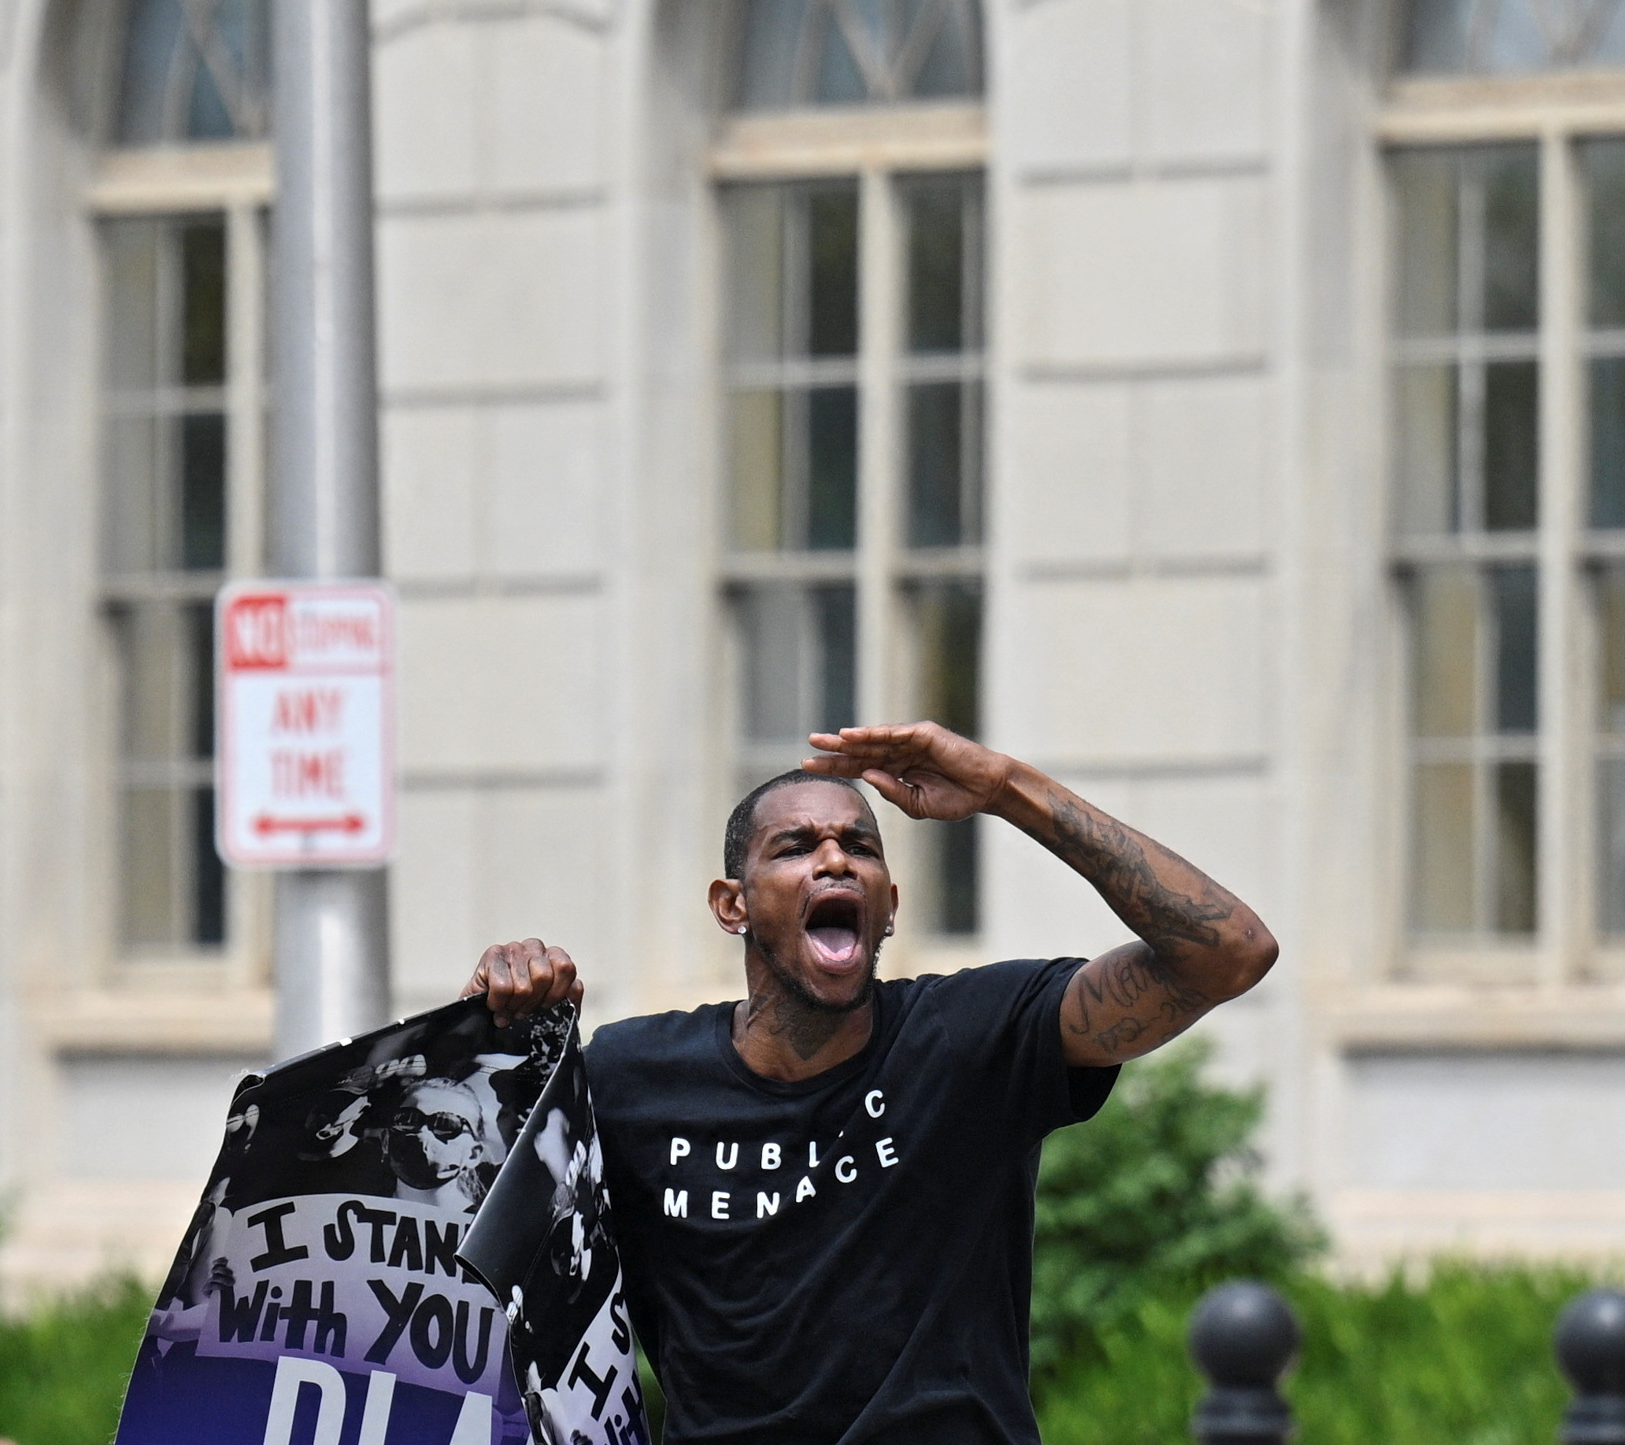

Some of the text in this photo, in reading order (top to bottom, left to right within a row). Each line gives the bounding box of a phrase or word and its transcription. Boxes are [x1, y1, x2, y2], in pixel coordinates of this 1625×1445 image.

[234, 610, 283, 657] NO
[270, 688, 345, 734] ANY
[269, 747, 346, 797] TIME
[669, 1089, 885, 1170] PUBLC
[663, 1137, 899, 1220] MENACE
[248, 1201, 309, 1273] I
[363, 1279, 495, 1385] YOU
